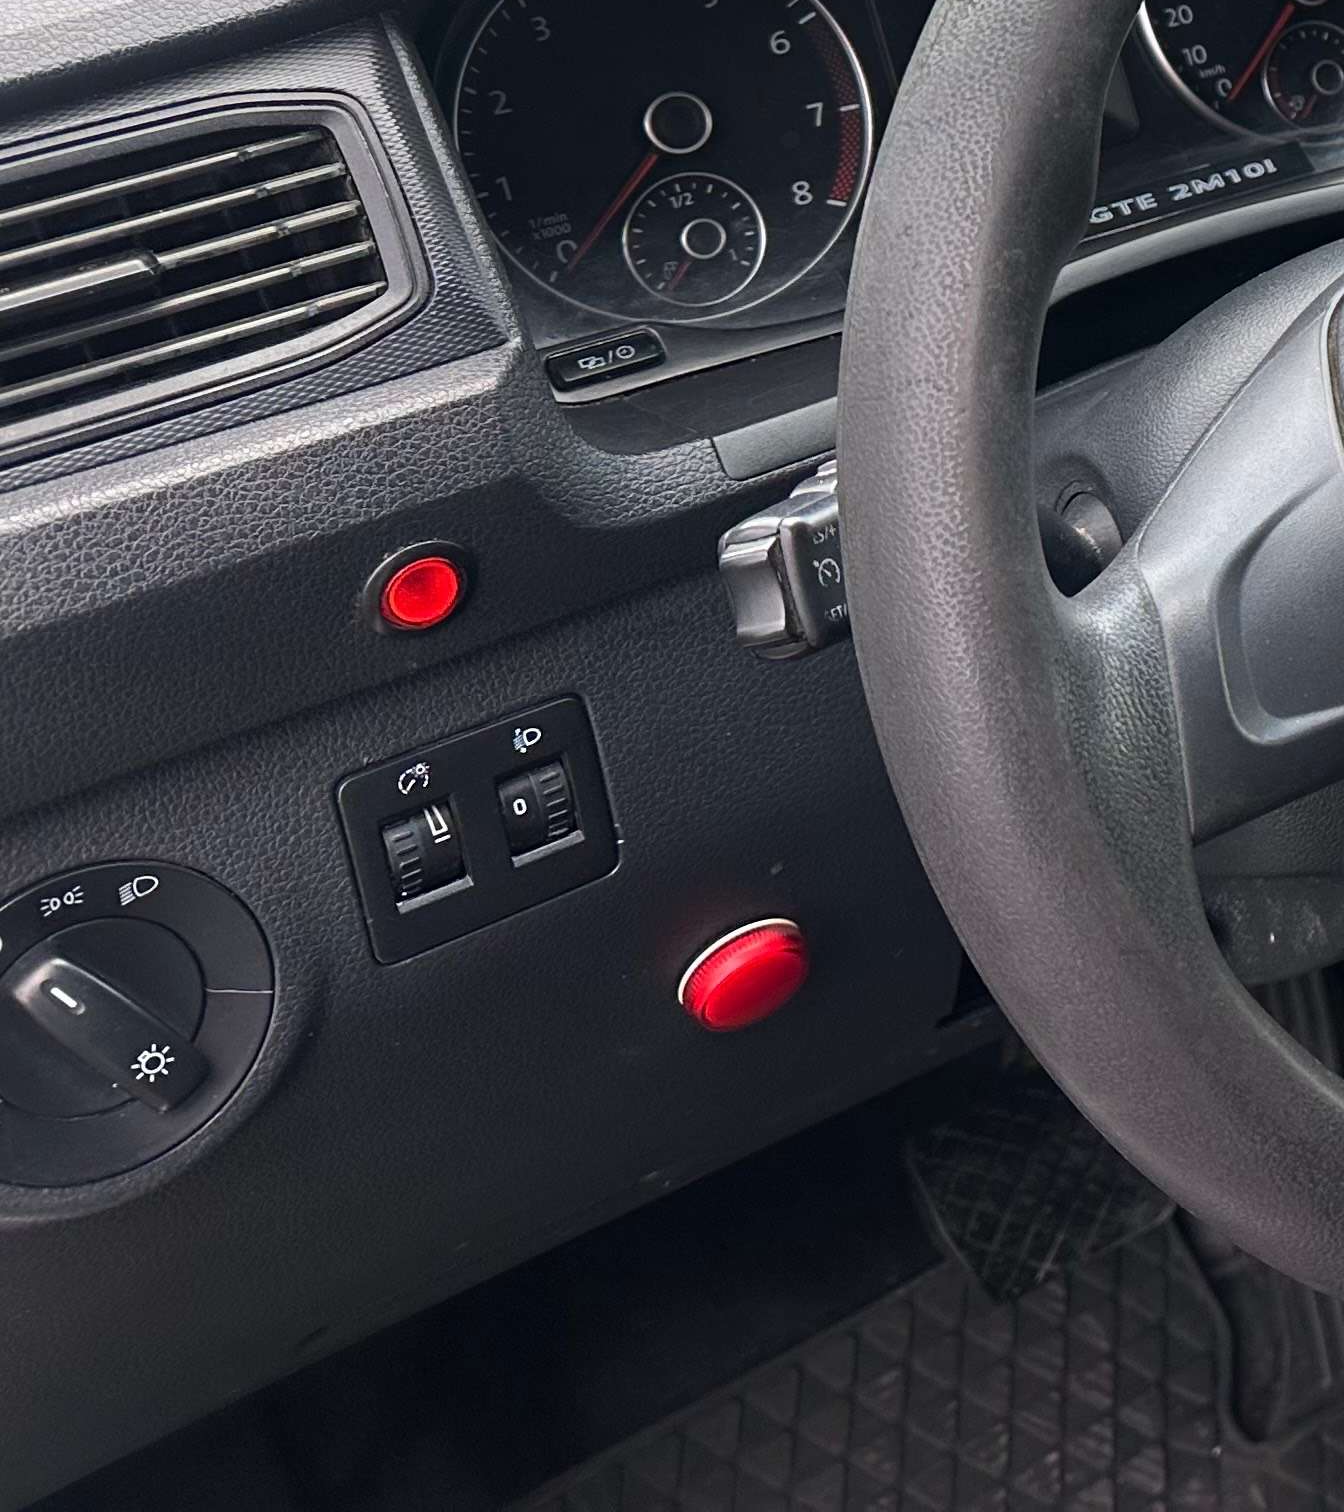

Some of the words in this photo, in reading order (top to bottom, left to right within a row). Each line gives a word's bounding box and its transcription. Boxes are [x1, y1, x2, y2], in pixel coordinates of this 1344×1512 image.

[1164, 4, 1194, 28] 20
[533, 16, 552, 42] 3
[770, 31, 791, 56] 6
[1182, 45, 1208, 67] 10
[489, 90, 513, 116] 2
[806, 102, 825, 127] 7
[495, 177, 513, 202] 1
[792, 181, 813, 205] 8
[512, 797, 528, 816] 0
